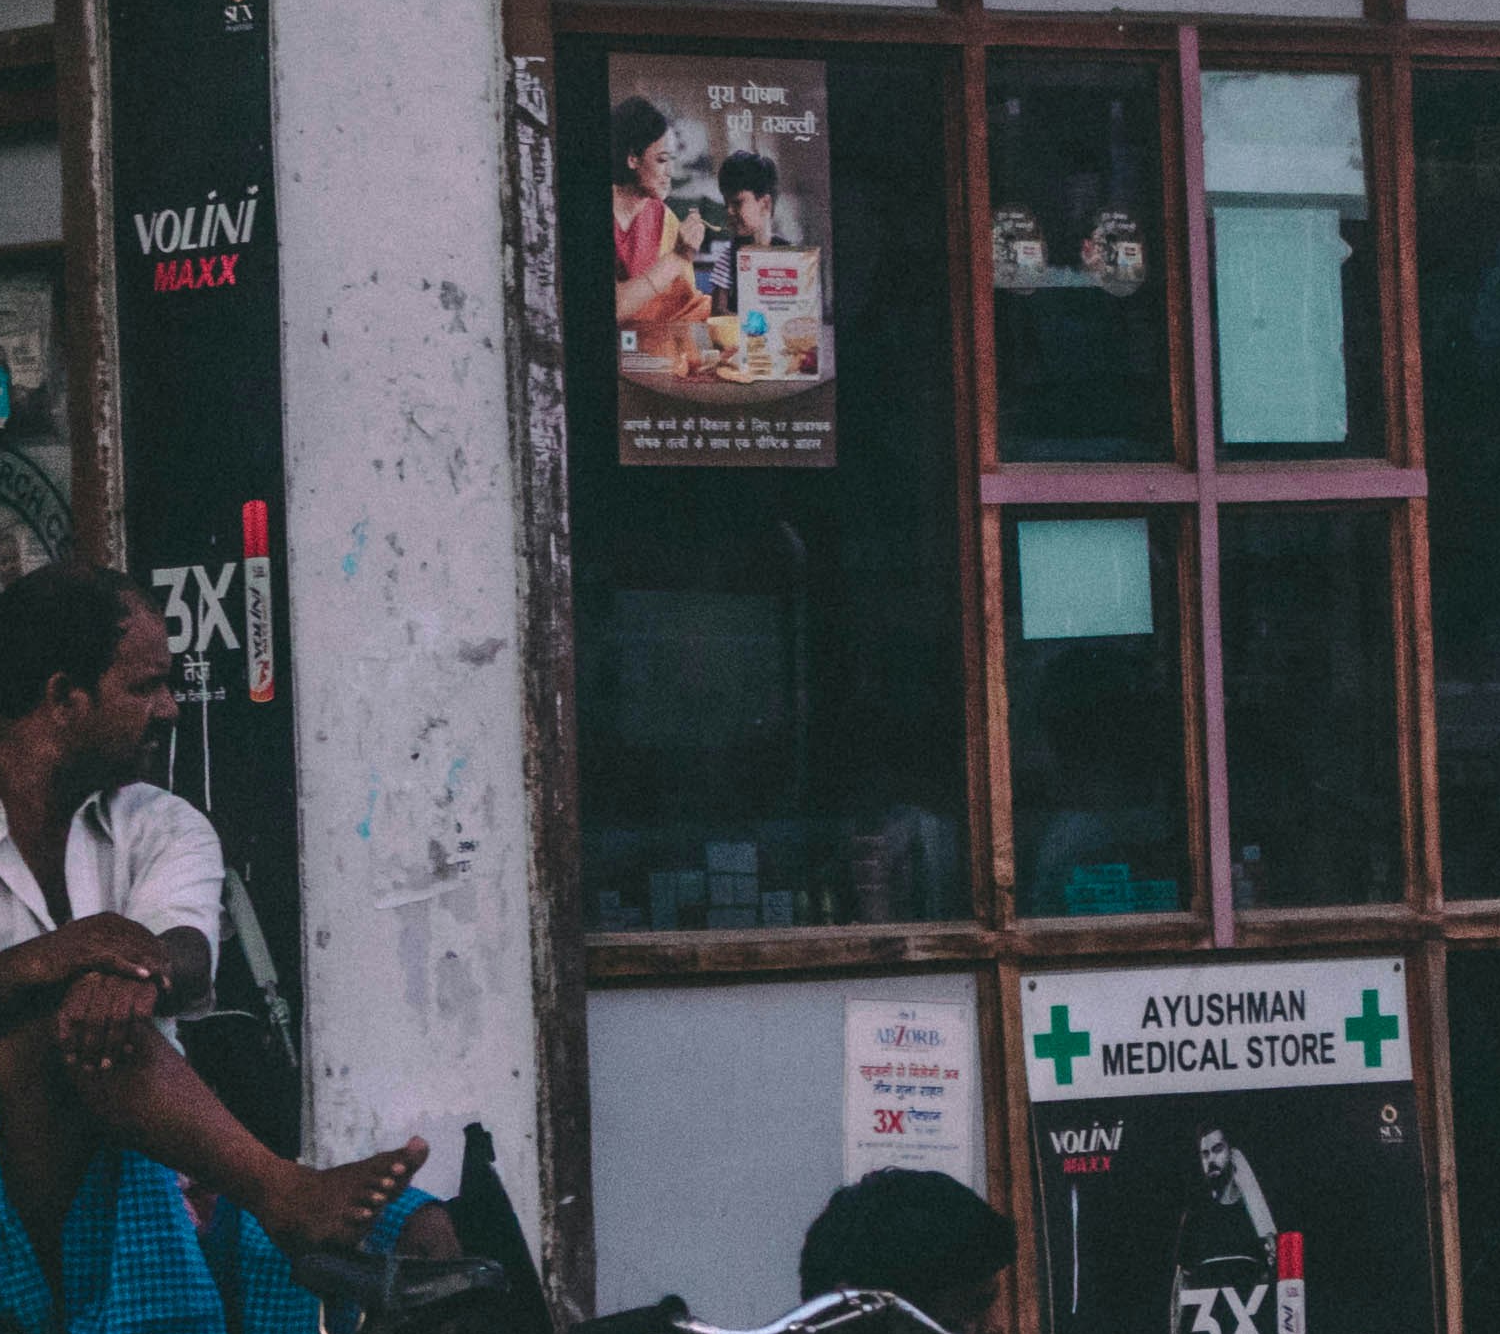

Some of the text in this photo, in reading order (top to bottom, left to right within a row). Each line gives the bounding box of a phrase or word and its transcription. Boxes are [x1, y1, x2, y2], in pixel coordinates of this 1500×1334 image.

[153, 253, 242, 293] MAXX
[150, 561, 242, 656] 3X
[1141, 989, 1307, 1030] AYUSHMAN
[875, 1025, 941, 1047] ABZORB
[1101, 1031, 1336, 1077] MEDICAL STORE
[872, 1108, 905, 1135] 3X
[1062, 1155, 1112, 1175] MAXX
